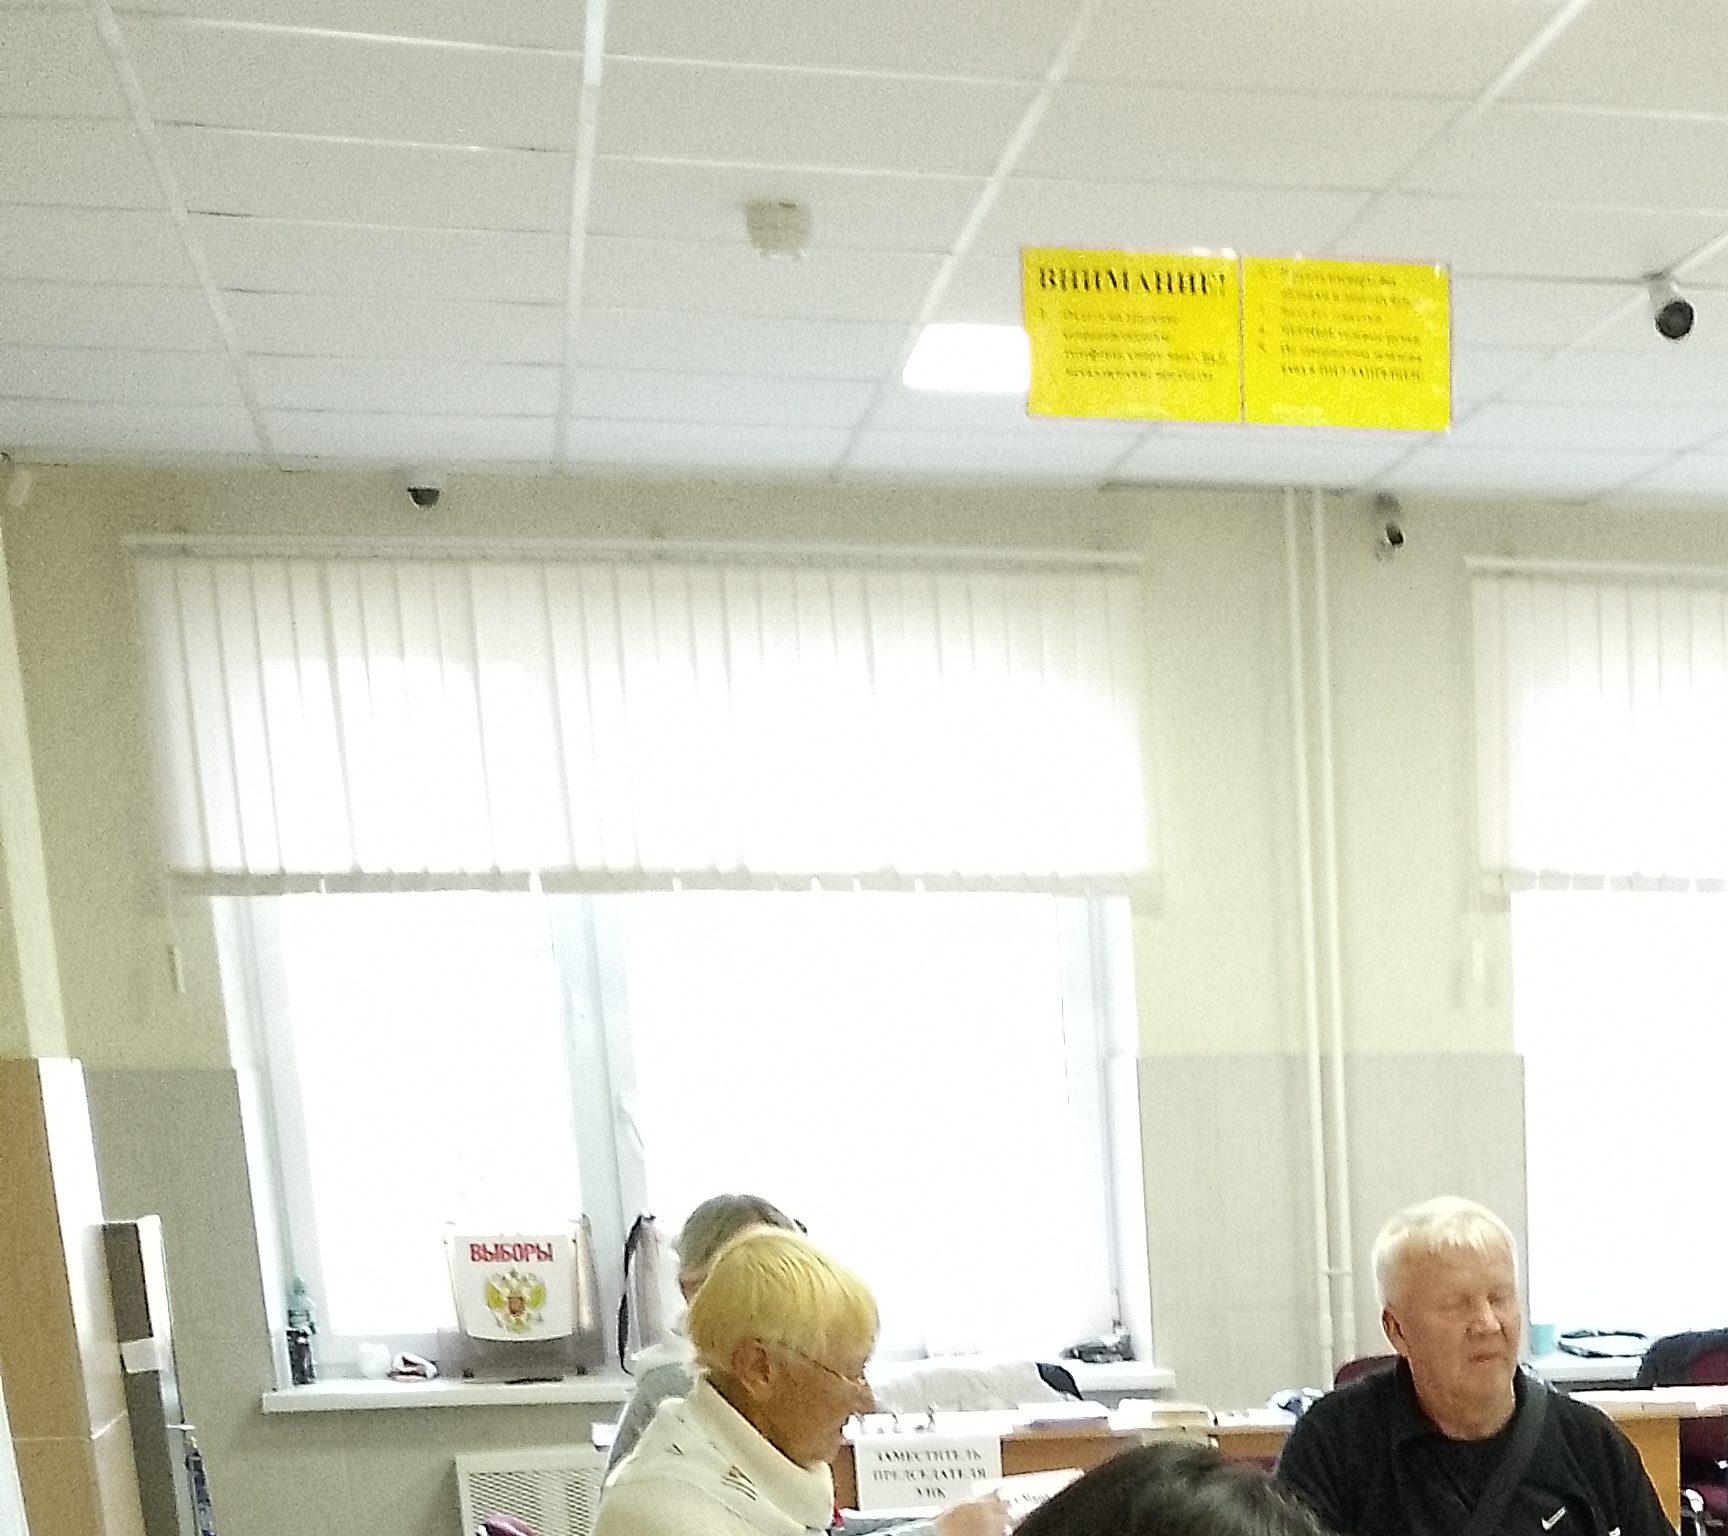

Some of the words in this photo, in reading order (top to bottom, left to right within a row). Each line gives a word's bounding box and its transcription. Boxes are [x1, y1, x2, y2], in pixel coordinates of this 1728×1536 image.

[1039, 267, 1226, 296] ВНИМАНИЕ!
[469, 1243, 554, 1262] ВЫБОРЫ
[875, 1447, 981, 1463] ЗАМЕСТИТЕЛЬ
[872, 1466, 987, 1481] ПРЕДСЕДАТЕЛЯ
